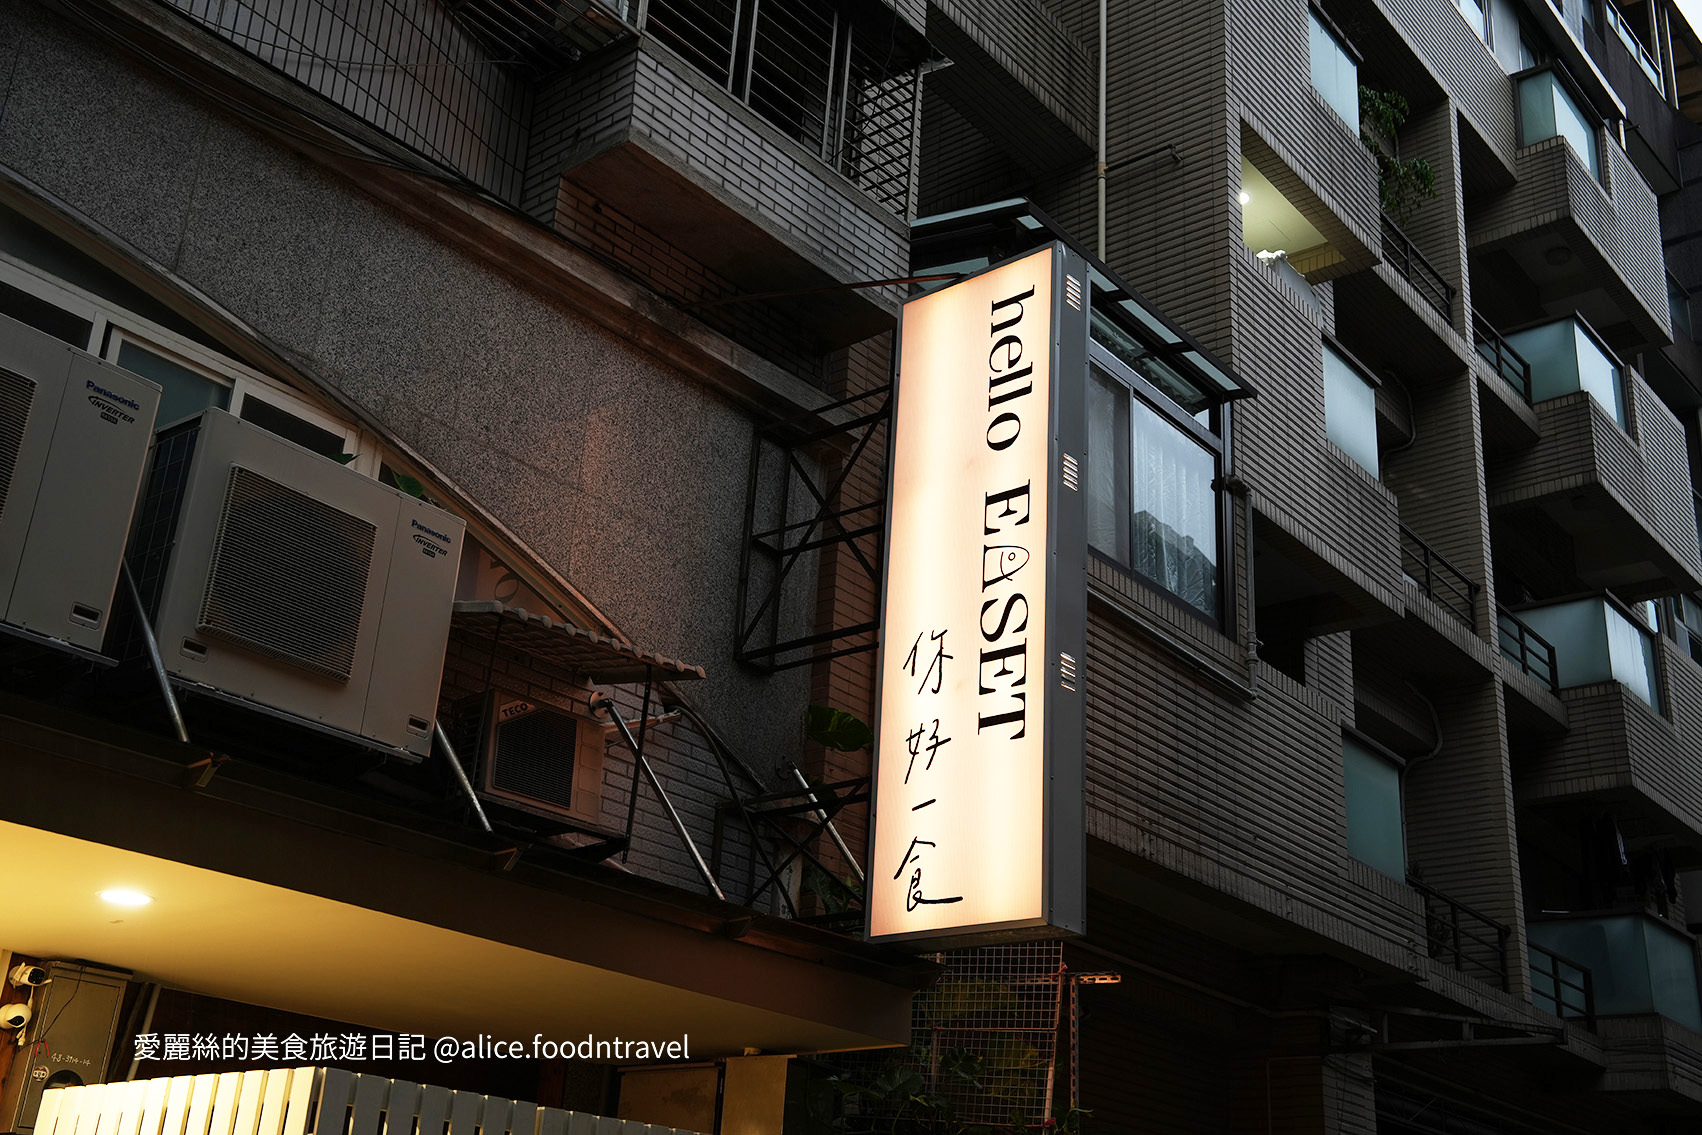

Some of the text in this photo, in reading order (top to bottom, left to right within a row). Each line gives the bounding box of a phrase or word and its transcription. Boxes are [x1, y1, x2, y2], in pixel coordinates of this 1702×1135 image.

[986, 284, 1035, 451] hello
[86, 380, 140, 411] Panasonic
[90, 399, 135, 424] INVERTER
[412, 519, 452, 544] Panasonic
[415, 537, 448, 557] INVERTER
[502, 702, 528, 718] TECO
[893, 629, 964, 912] 你好一食
